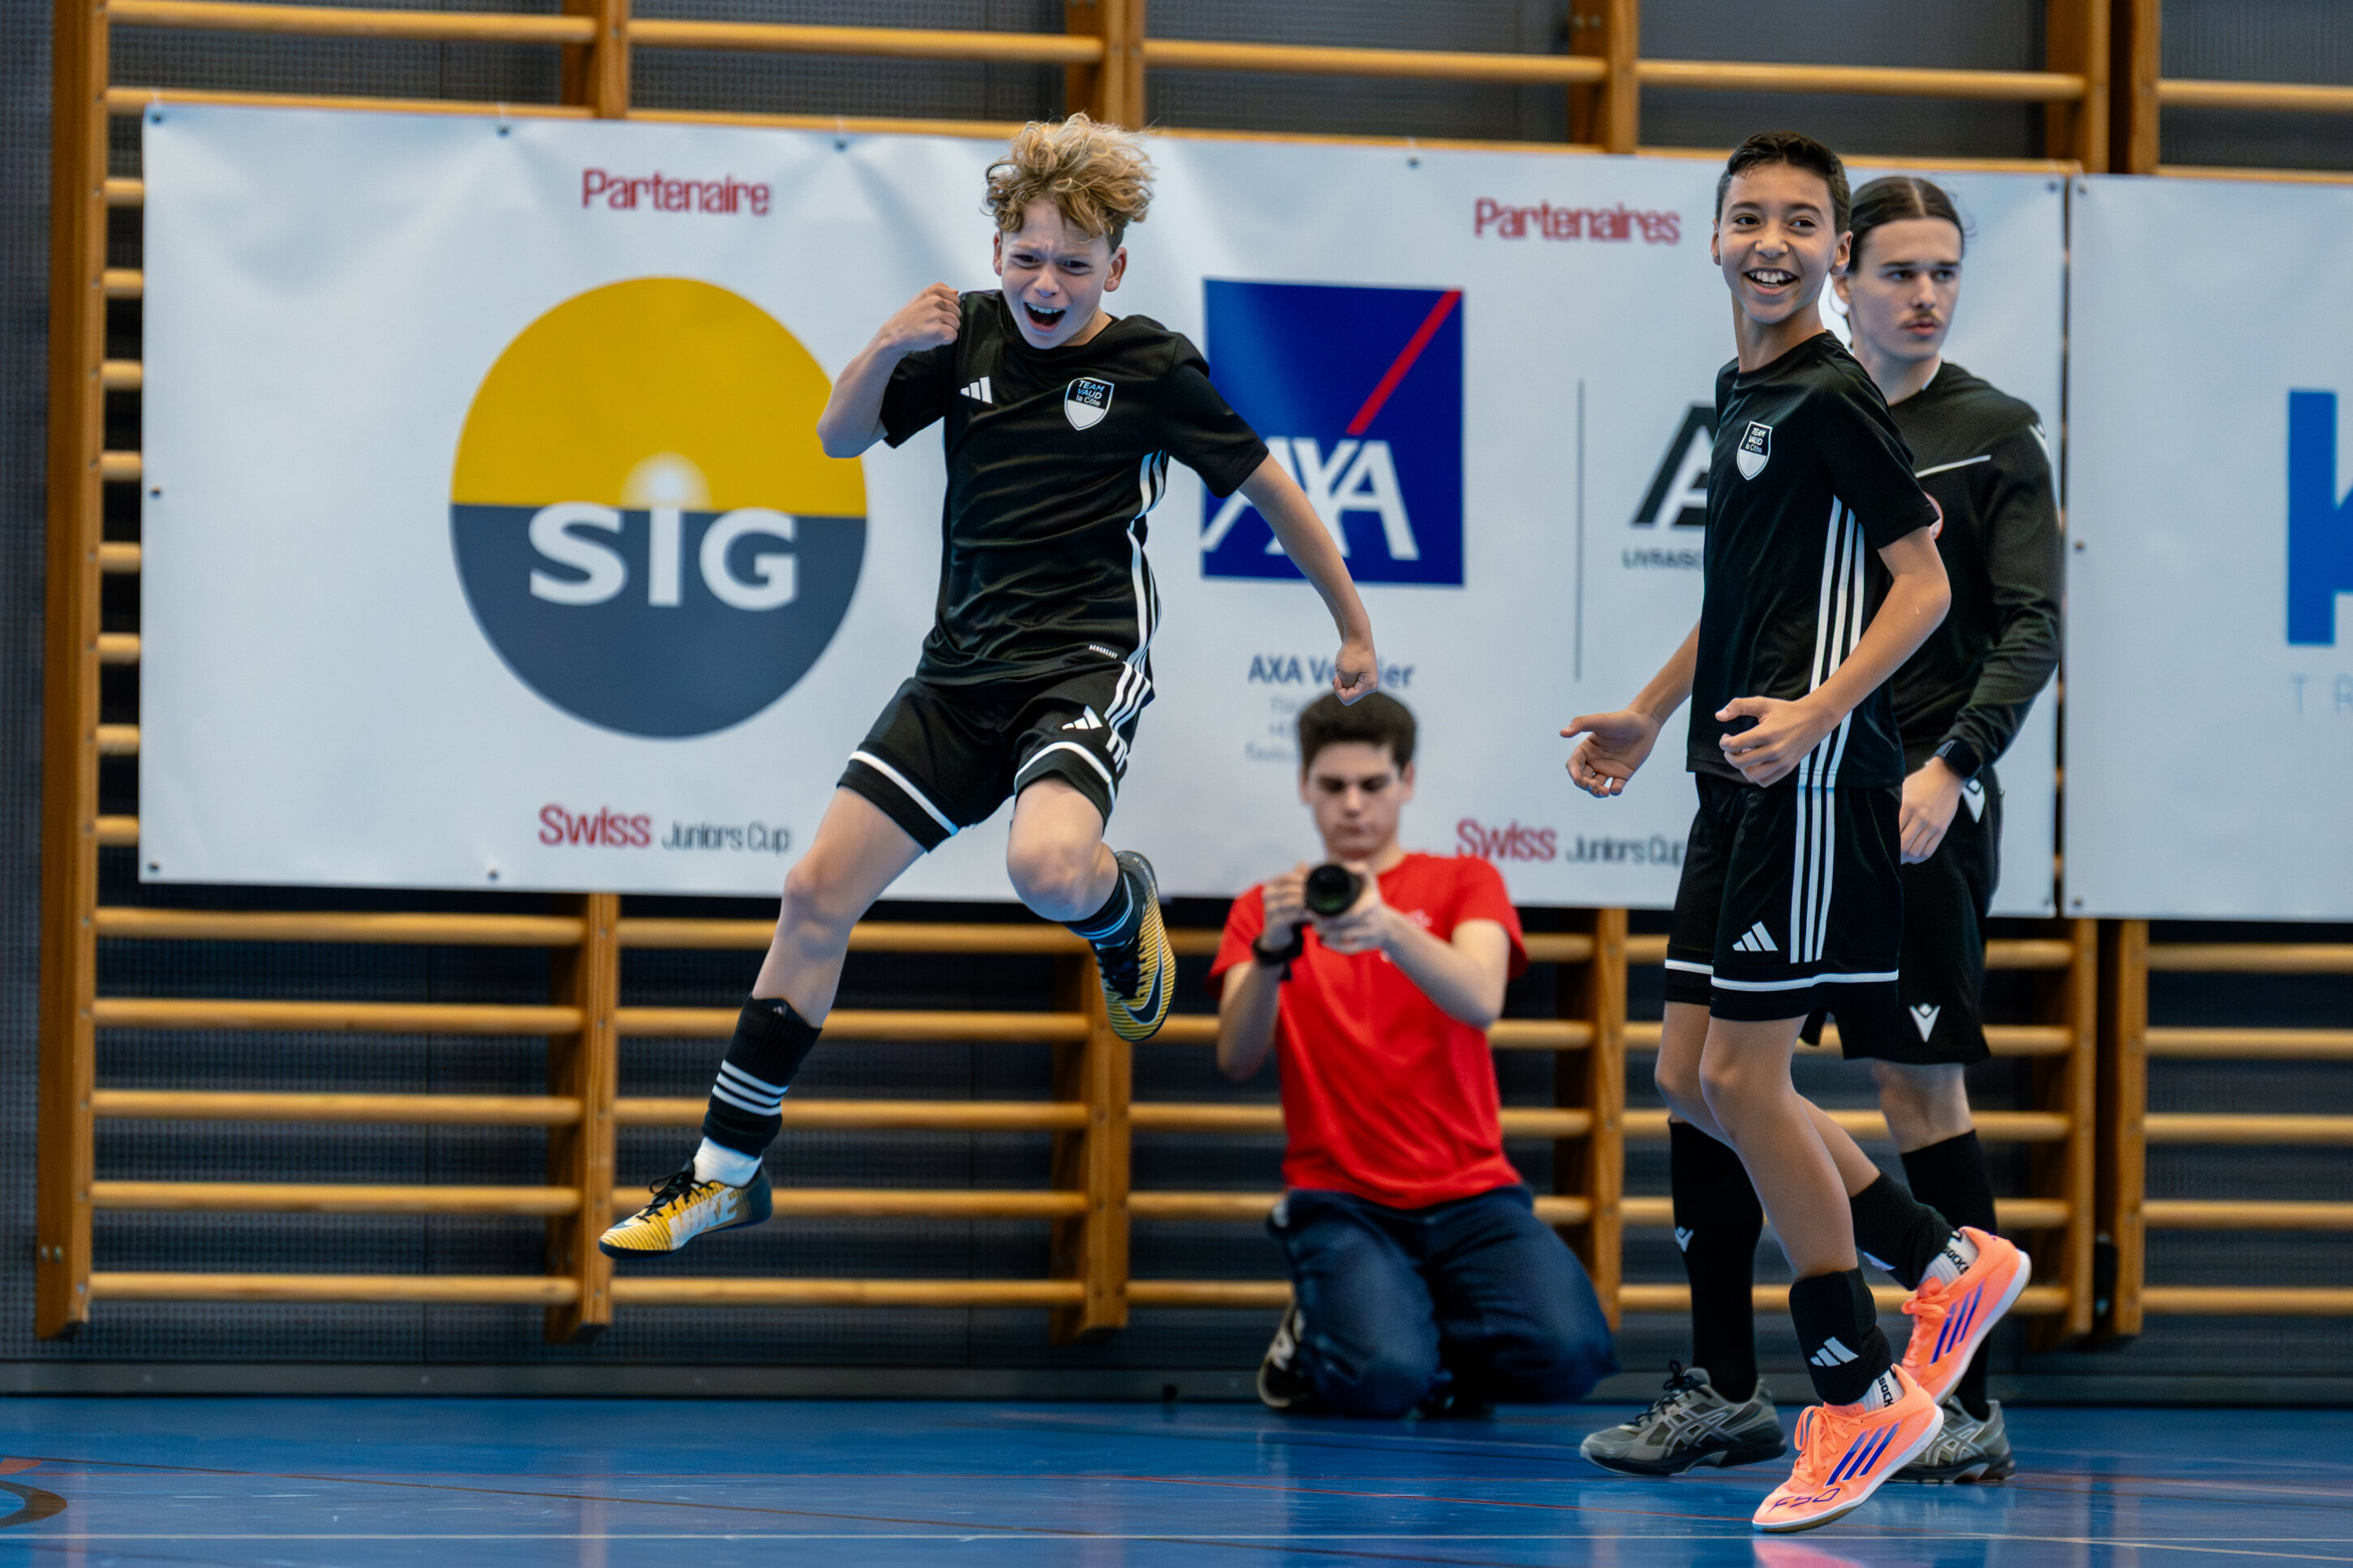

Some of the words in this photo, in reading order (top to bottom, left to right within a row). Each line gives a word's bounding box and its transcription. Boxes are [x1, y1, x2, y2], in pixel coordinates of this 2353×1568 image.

[581, 168, 770, 217] Partenaire
[1474, 197, 1680, 245] Partenaires
[1078, 380, 1105, 392] TEAM
[1078, 389, 1103, 399] VAUD
[1749, 436, 1763, 445] VAUD
[1752, 427, 1766, 437] TEAM
[1202, 436, 1419, 560] AXA
[528, 500, 798, 612] SIG
[1249, 655, 1302, 684] AXA
[1309, 655, 1413, 688] Vier
[539, 804, 652, 847] Swiss
[661, 820, 742, 852] Juniors
[747, 821, 790, 855] Cup
[1457, 818, 1556, 861] Swiss
[1567, 836, 1644, 864] Juniors
[1768, 1488, 1840, 1513] F50
